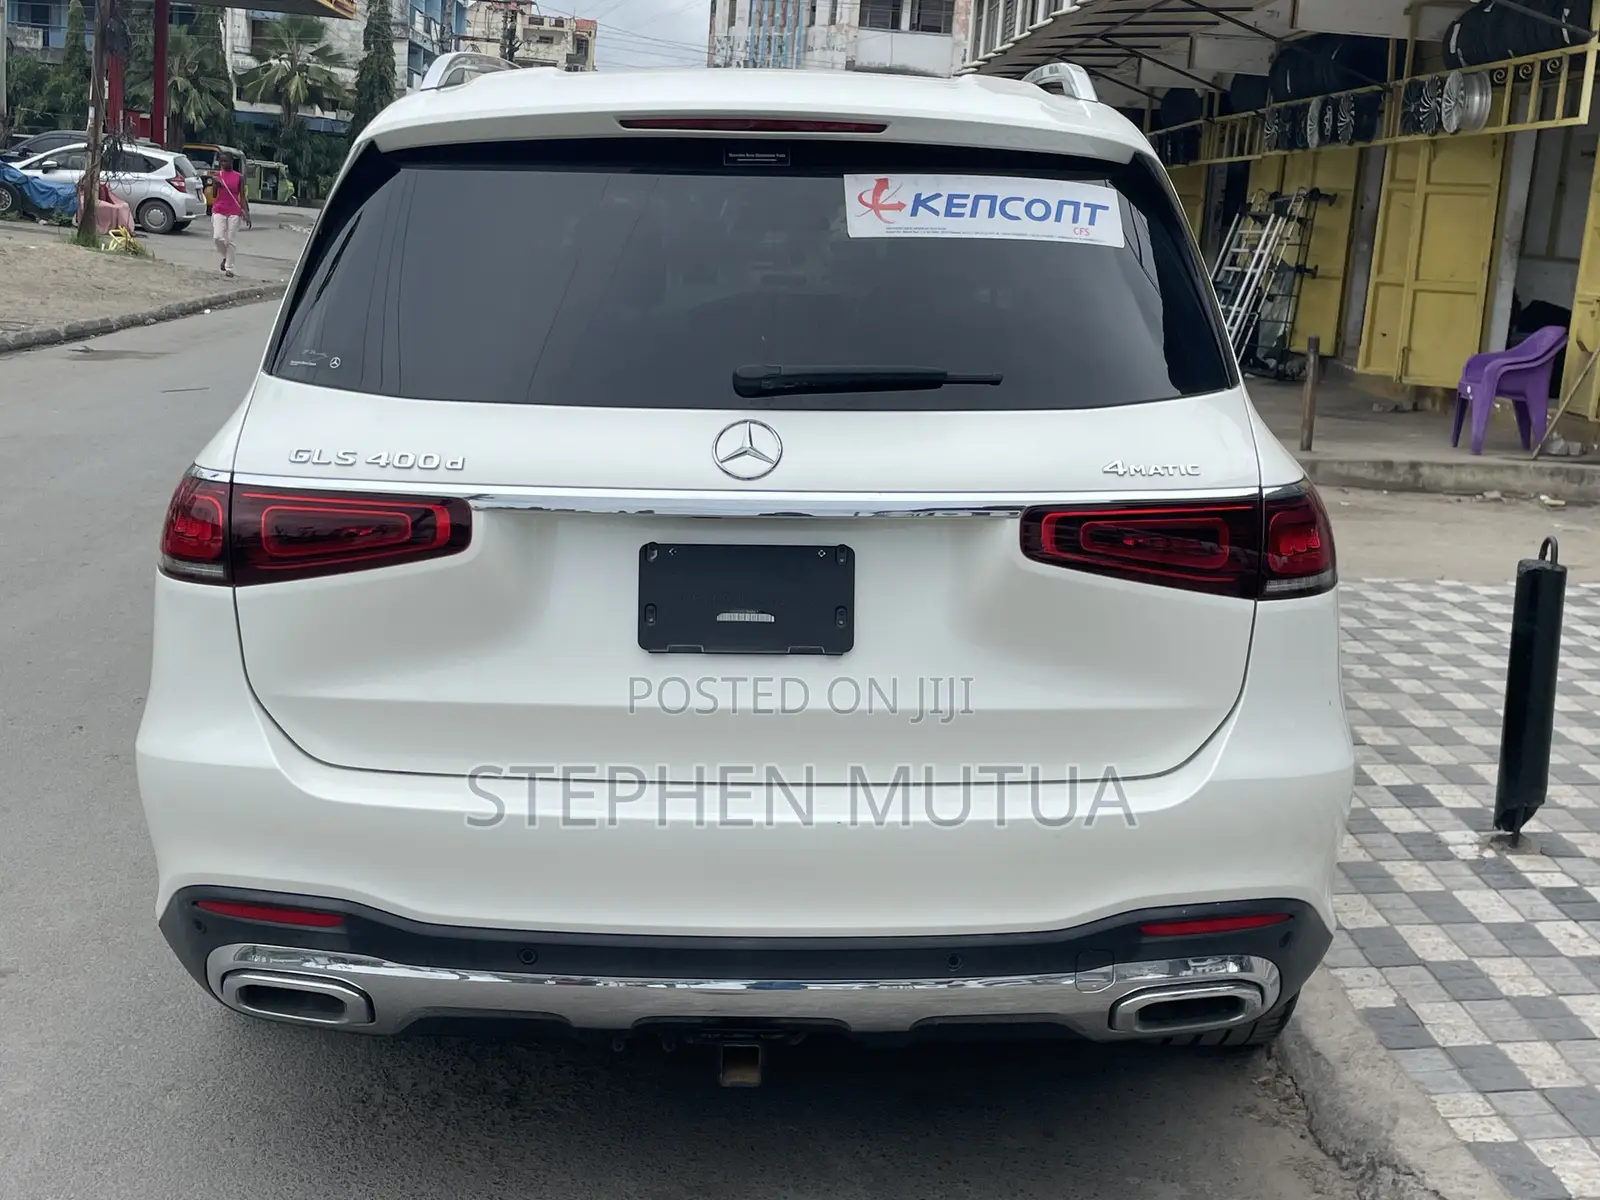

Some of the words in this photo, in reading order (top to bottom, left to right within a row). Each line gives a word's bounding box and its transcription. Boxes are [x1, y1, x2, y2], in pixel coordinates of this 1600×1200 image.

[1073, 227, 1091, 237] CFS
[289, 448, 358, 467] GLS
[1102, 459, 1201, 477] 4MATIC
